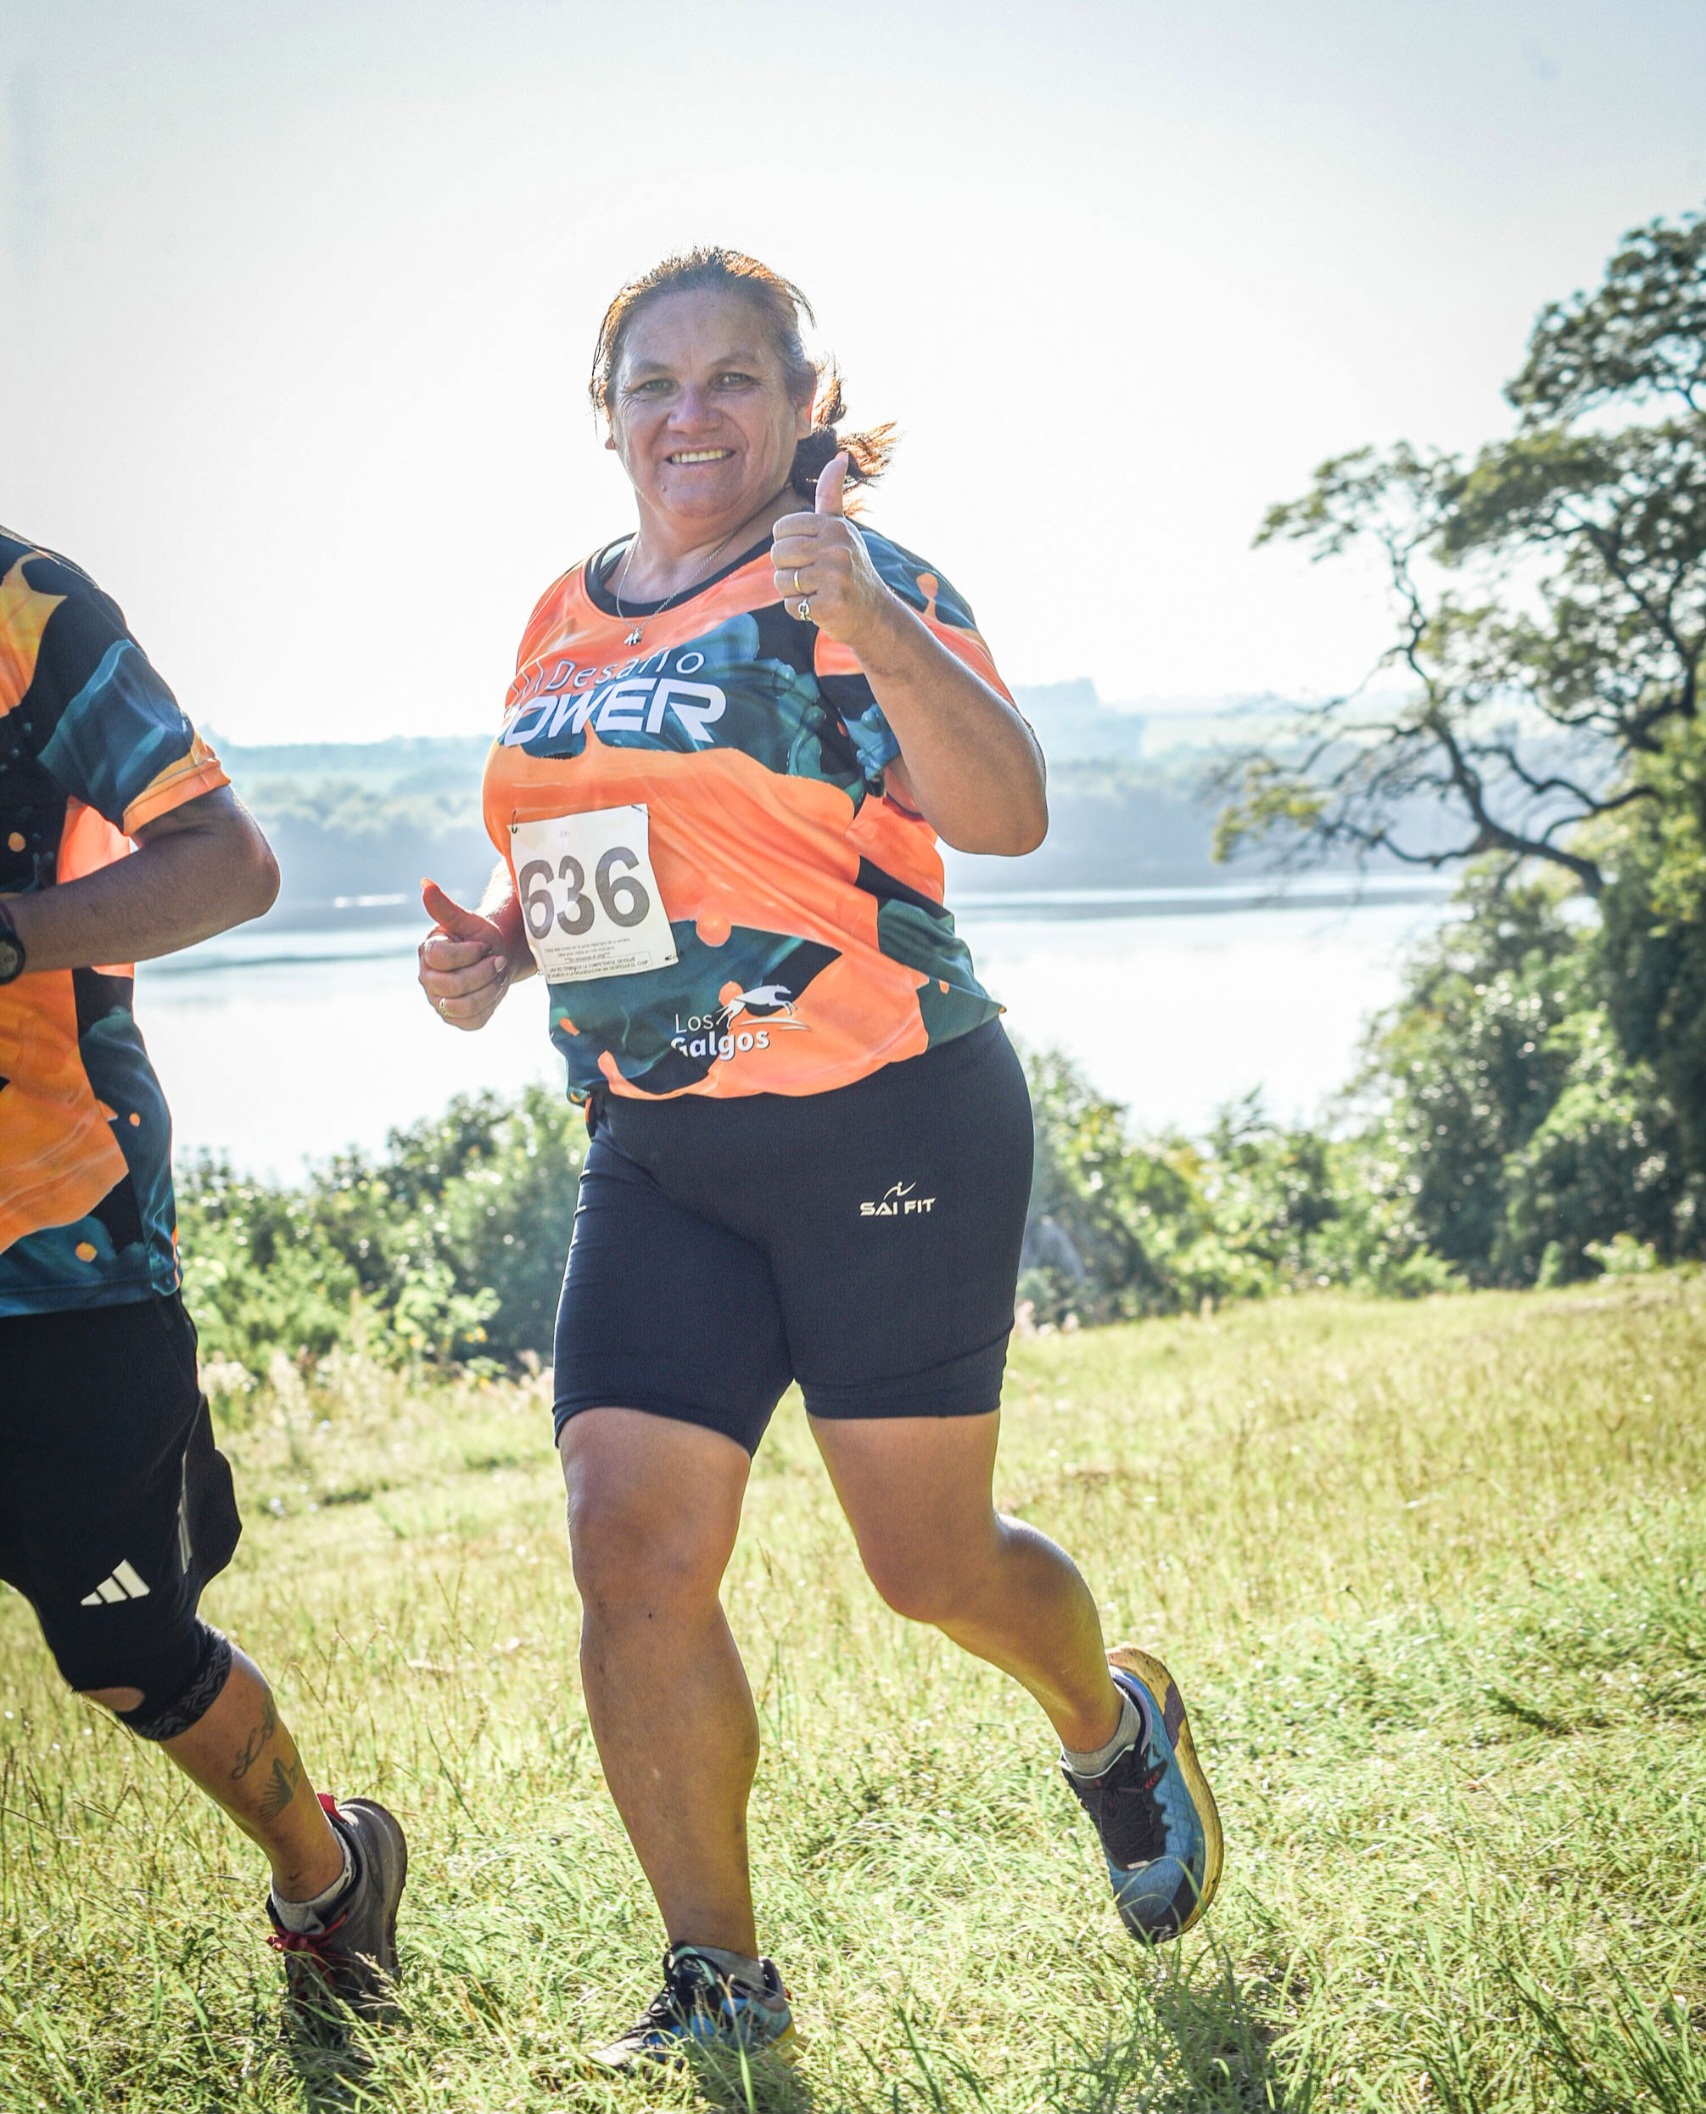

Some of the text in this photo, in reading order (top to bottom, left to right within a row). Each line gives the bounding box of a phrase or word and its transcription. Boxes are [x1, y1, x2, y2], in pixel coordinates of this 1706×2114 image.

[518, 846, 651, 940] 636
[674, 1013, 714, 1034] Los
[670, 1030, 770, 1061] Galgos
[859, 1197, 937, 1216] SAI FIT
